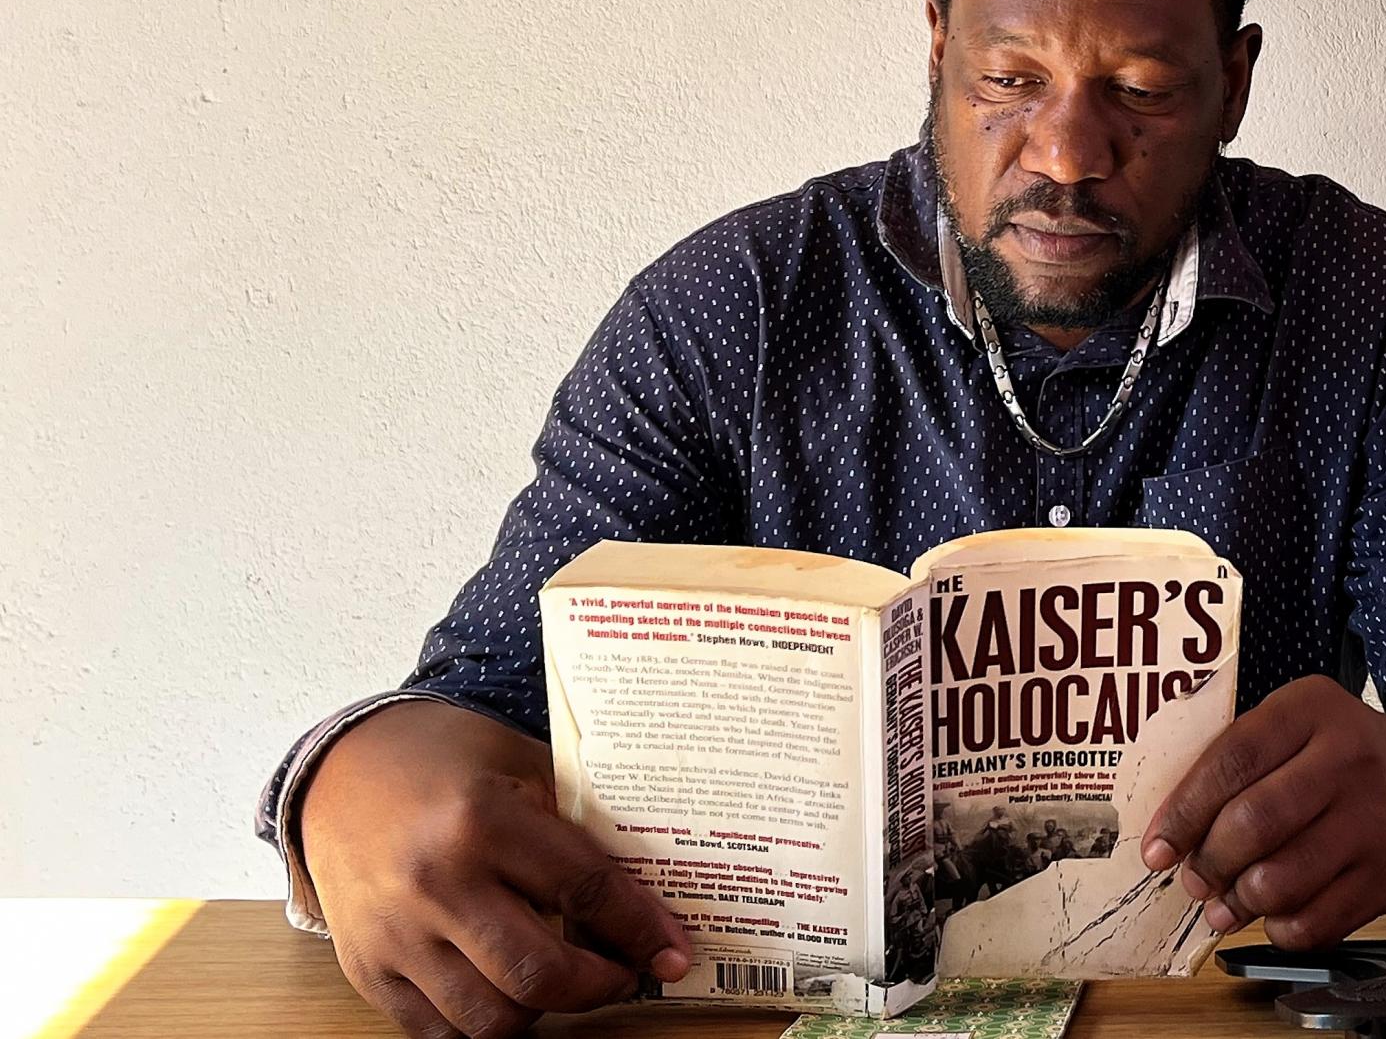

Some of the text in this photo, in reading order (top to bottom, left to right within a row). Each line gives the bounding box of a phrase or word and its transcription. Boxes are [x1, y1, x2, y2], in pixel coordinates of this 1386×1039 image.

[931, 575, 963, 593] HE
[581, 597, 608, 608] vivid,
[611, 599, 654, 609] powerful
[657, 602, 701, 611] narrative
[704, 603, 714, 612] of
[717, 604, 732, 613] the
[735, 605, 781, 617] Namibian
[784, 611, 829, 622] genocide
[832, 616, 850, 625] and
[570, 614, 851, 641] a compelling sketch of the multiple connections between
[930, 580, 1224, 685] KAISER'S
[588, 629, 629, 639] Namibia
[632, 631, 650, 640] and
[697, 633, 737, 644] Stephen
[739, 636, 769, 648] Howe,
[772, 640, 835, 654] INDEPENDENT
[884, 628, 911, 659] CASPER
[886, 673, 898, 745] GERMANY'S
[931, 670, 1219, 758] HOLOCAUS
[898, 655, 927, 861] THE KAISER'S HOLOCAUST
[887, 742, 899, 812] FORGOTTEN
[959, 787, 991, 797] colonial
[994, 785, 1019, 795] period
[1022, 784, 1048, 793] played
[981, 777, 995, 785] The
[998, 774, 1027, 783] authors
[1030, 771, 1071, 781] powerfully
[1074, 771, 1095, 779] show
[1009, 795, 1033, 804] Paddy
[1035, 793, 1073, 802] Docherty,
[675, 837, 769, 852] Gavin Bowd, SCOTSMAN
